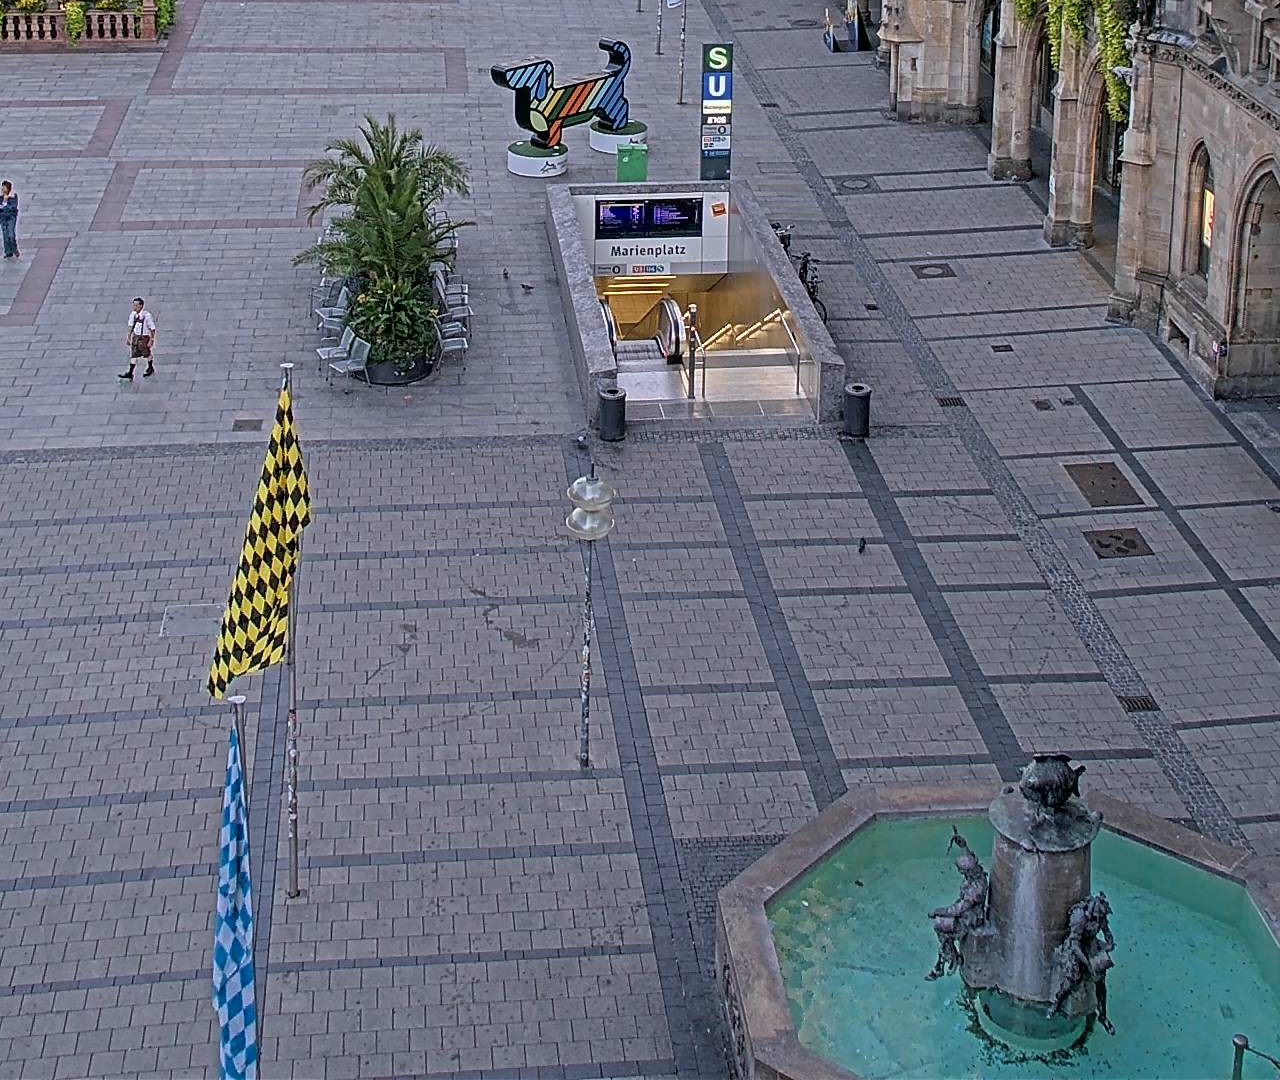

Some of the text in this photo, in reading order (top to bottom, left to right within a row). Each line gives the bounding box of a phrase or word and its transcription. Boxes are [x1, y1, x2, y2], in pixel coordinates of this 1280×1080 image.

[708, 47, 728, 69] S
[708, 75, 726, 97] U
[610, 243, 687, 258] Marienplatz
